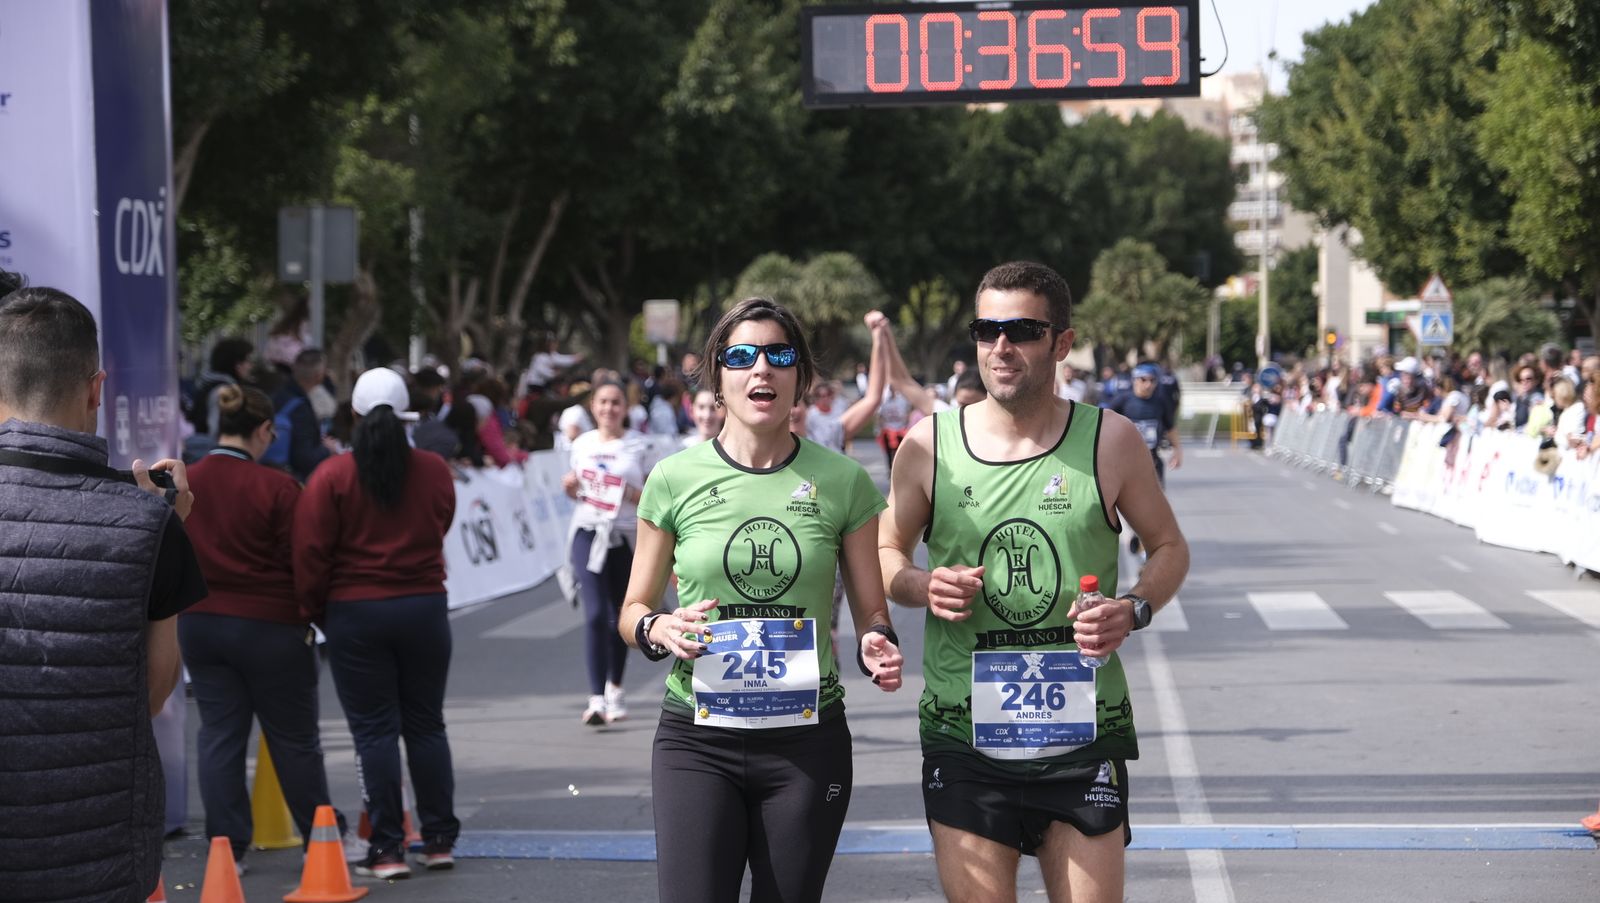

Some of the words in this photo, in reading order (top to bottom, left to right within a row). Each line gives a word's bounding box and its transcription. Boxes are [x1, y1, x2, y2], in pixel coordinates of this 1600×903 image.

[865, 6, 1181, 93] 00:36:59
[786, 505, 821, 515] HUÉSCAR
[1038, 503, 1072, 511] HUÉSCAR
[743, 522, 781, 535] HOTEL
[995, 525, 1037, 543] HOTEL
[732, 572, 793, 597] RESTAURANTE
[734, 607, 749, 617] EL
[752, 605, 791, 618] MAÑO
[989, 590, 1054, 622] RESTAURANTE
[712, 633, 738, 643] MUJER
[995, 633, 1012, 645] EL
[1015, 630, 1058, 644] MAÑO
[722, 651, 788, 680] 245
[743, 680, 768, 688] INMA
[1000, 683, 1066, 711] 246
[1016, 711, 1052, 719] ANDRÉS
